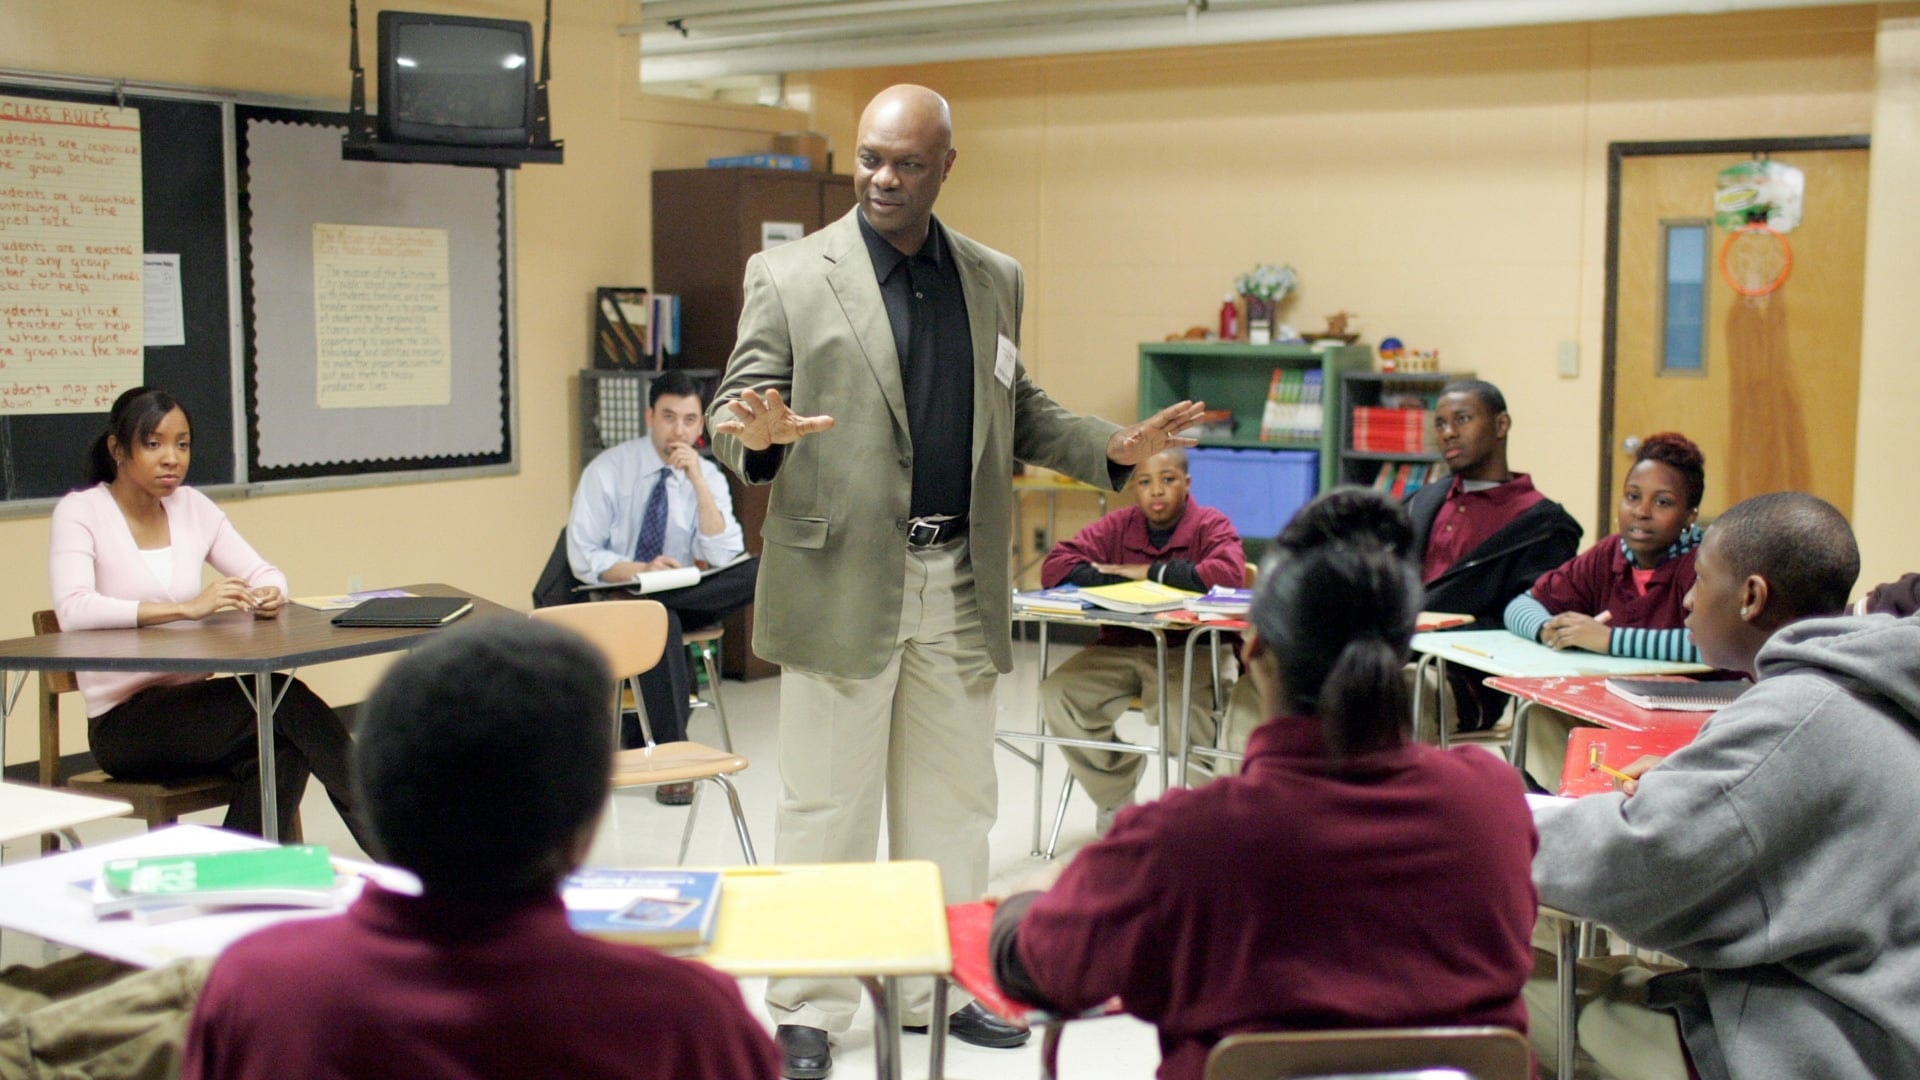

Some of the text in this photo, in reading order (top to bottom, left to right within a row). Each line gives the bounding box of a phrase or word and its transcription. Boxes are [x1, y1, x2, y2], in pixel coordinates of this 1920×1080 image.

[2, 102, 111, 127] CLASS RULES
[0, 131, 46, 147] udents
[58, 139, 78, 149] are
[35, 152, 58, 160] own
[0, 160, 64, 179] he group
[0, 187, 47, 200] udents
[0, 201, 117, 217] ontributing to the
[0, 214, 70, 230] gned task
[1, 240, 47, 252] udents
[56, 244, 76, 253] are
[36, 256, 62, 270] any
[71, 258, 111, 272] group
[37, 270, 66, 279] who
[30, 279, 51, 290] for
[1, 305, 120, 317] udents will ask
[7, 317, 131, 332] teacher for help
[9, 331, 119, 350] when everyone
[0, 348, 15, 356] he
[24, 348, 59, 362] group
[2, 379, 117, 396] udents may not
